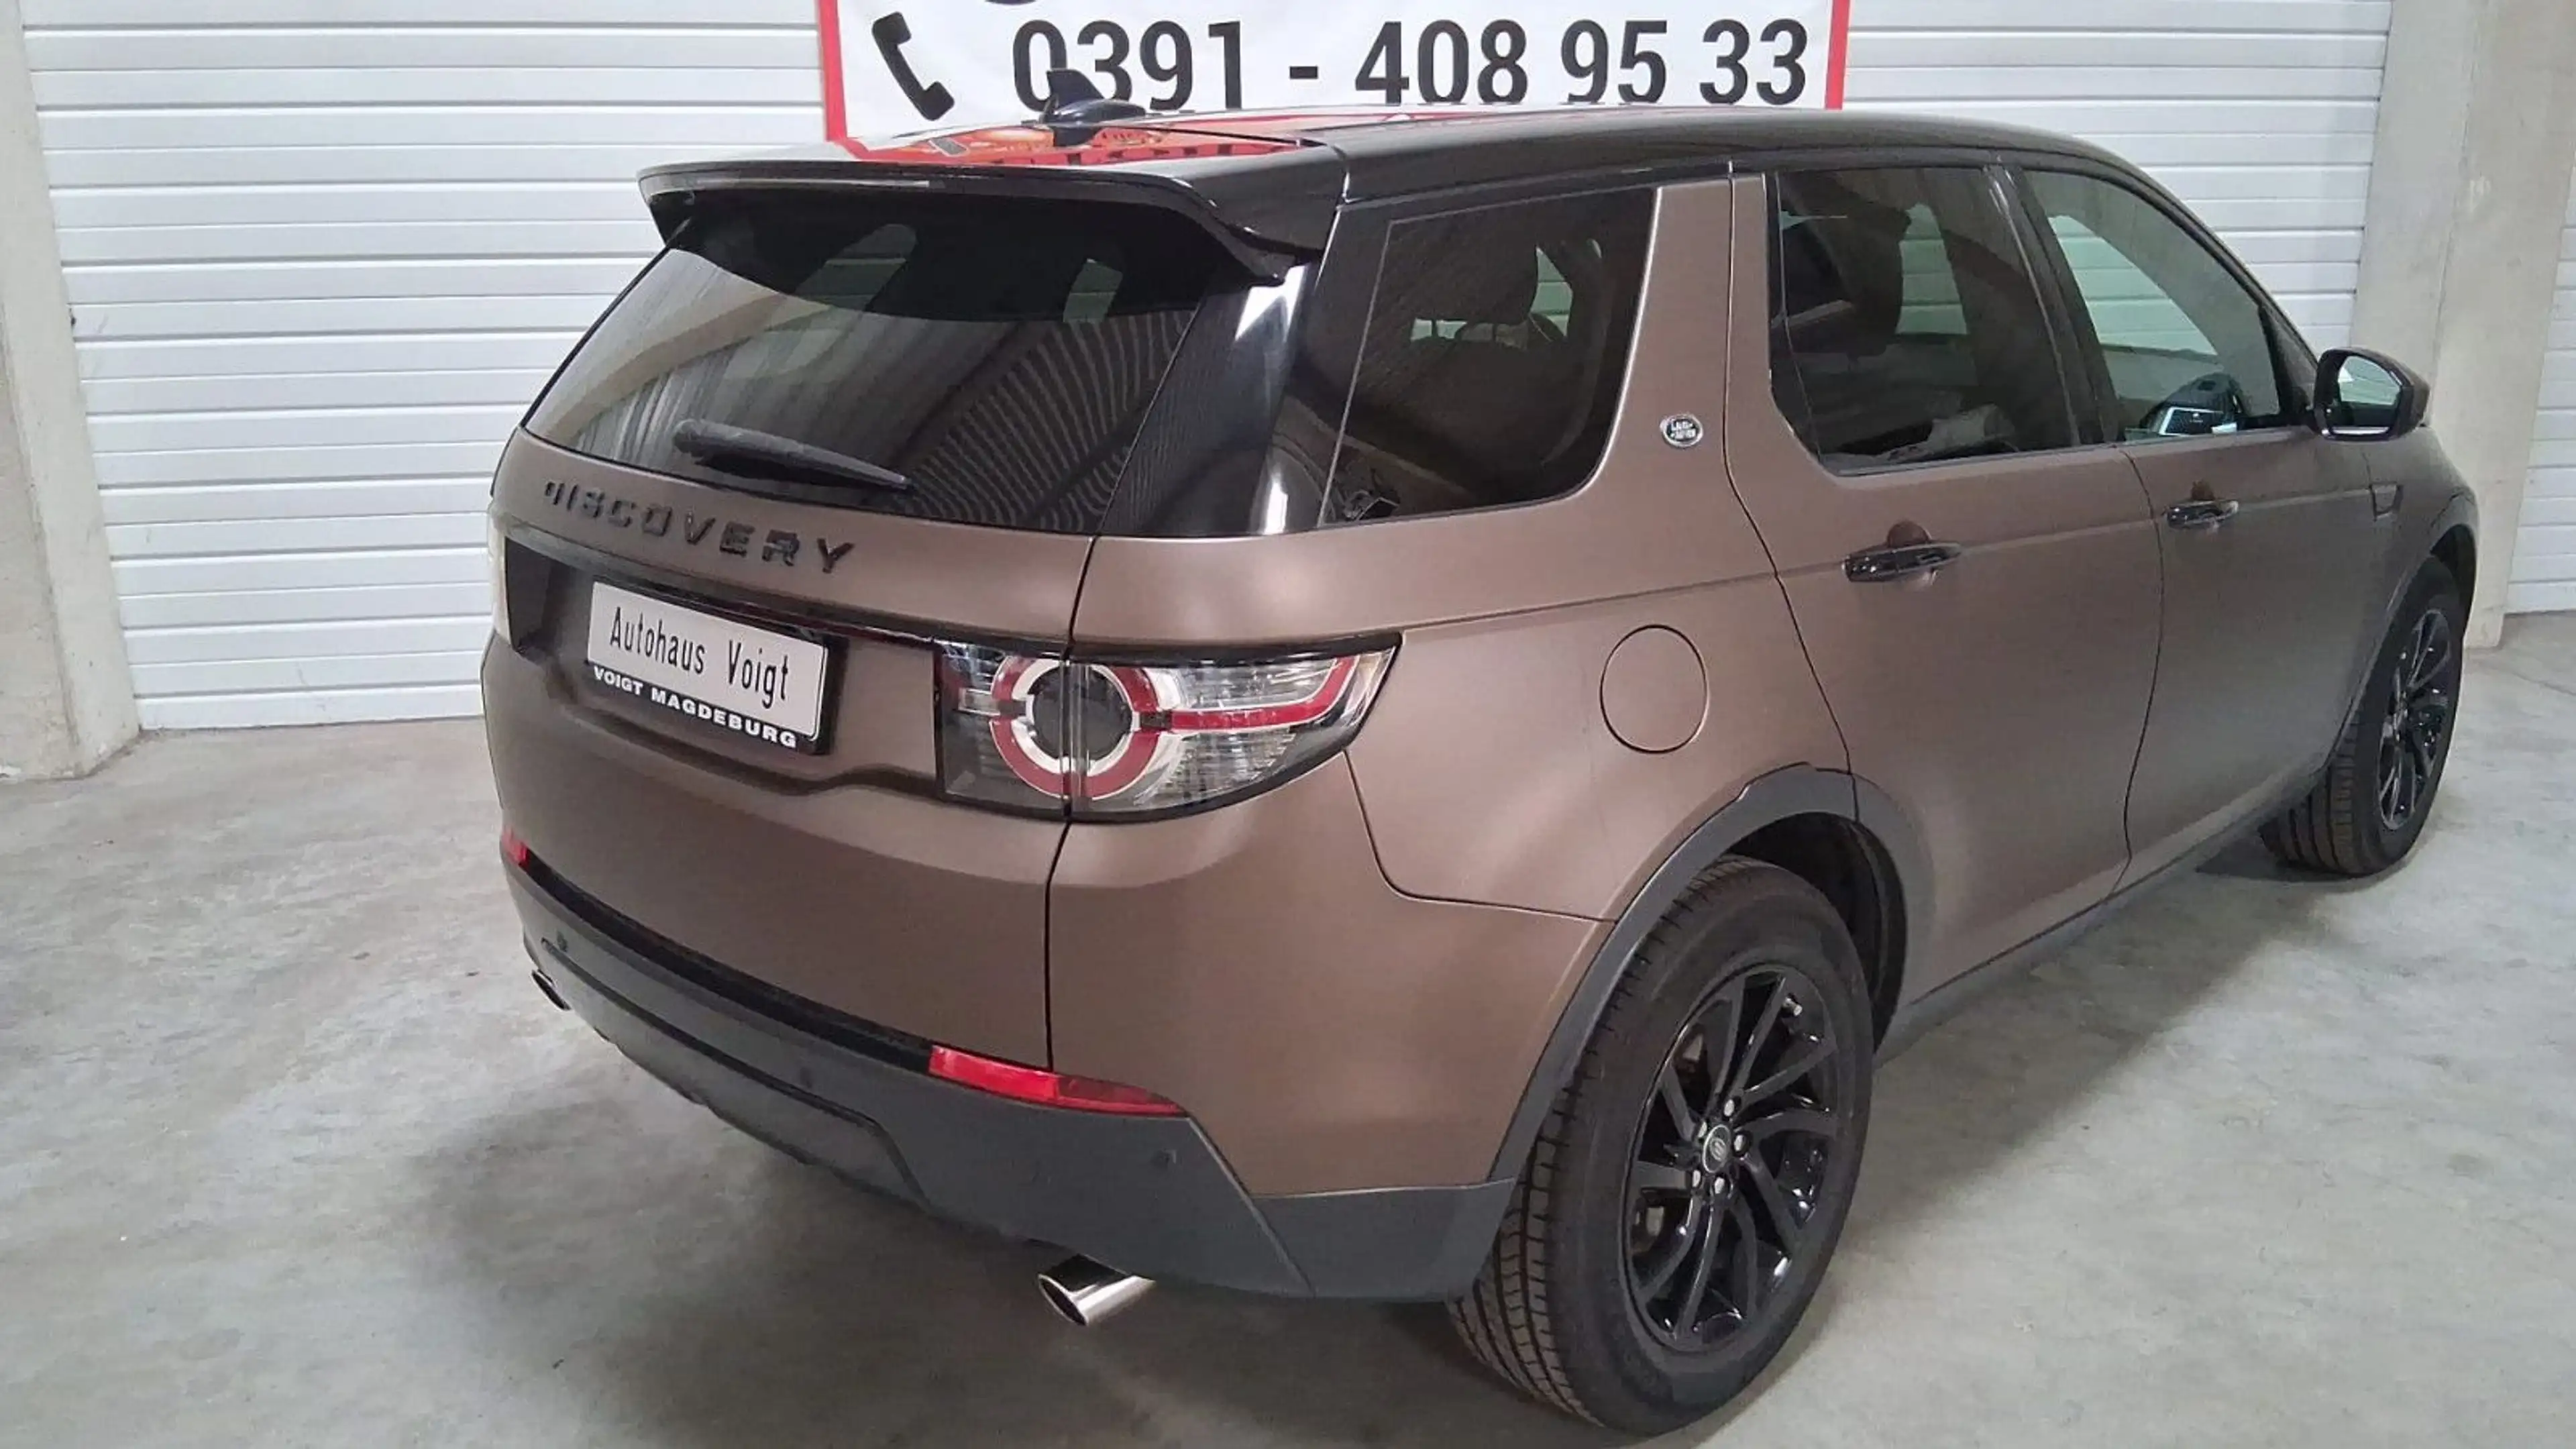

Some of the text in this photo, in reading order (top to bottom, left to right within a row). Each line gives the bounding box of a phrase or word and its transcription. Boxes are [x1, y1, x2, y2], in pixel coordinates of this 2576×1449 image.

[1013, 19, 1807, 111] 0391 - 408 95 33
[544, 481, 855, 574] DISCOVERY
[610, 606, 789, 709] Autohaus Voigt
[594, 665, 797, 748] VOIGT MAGDEBURG
